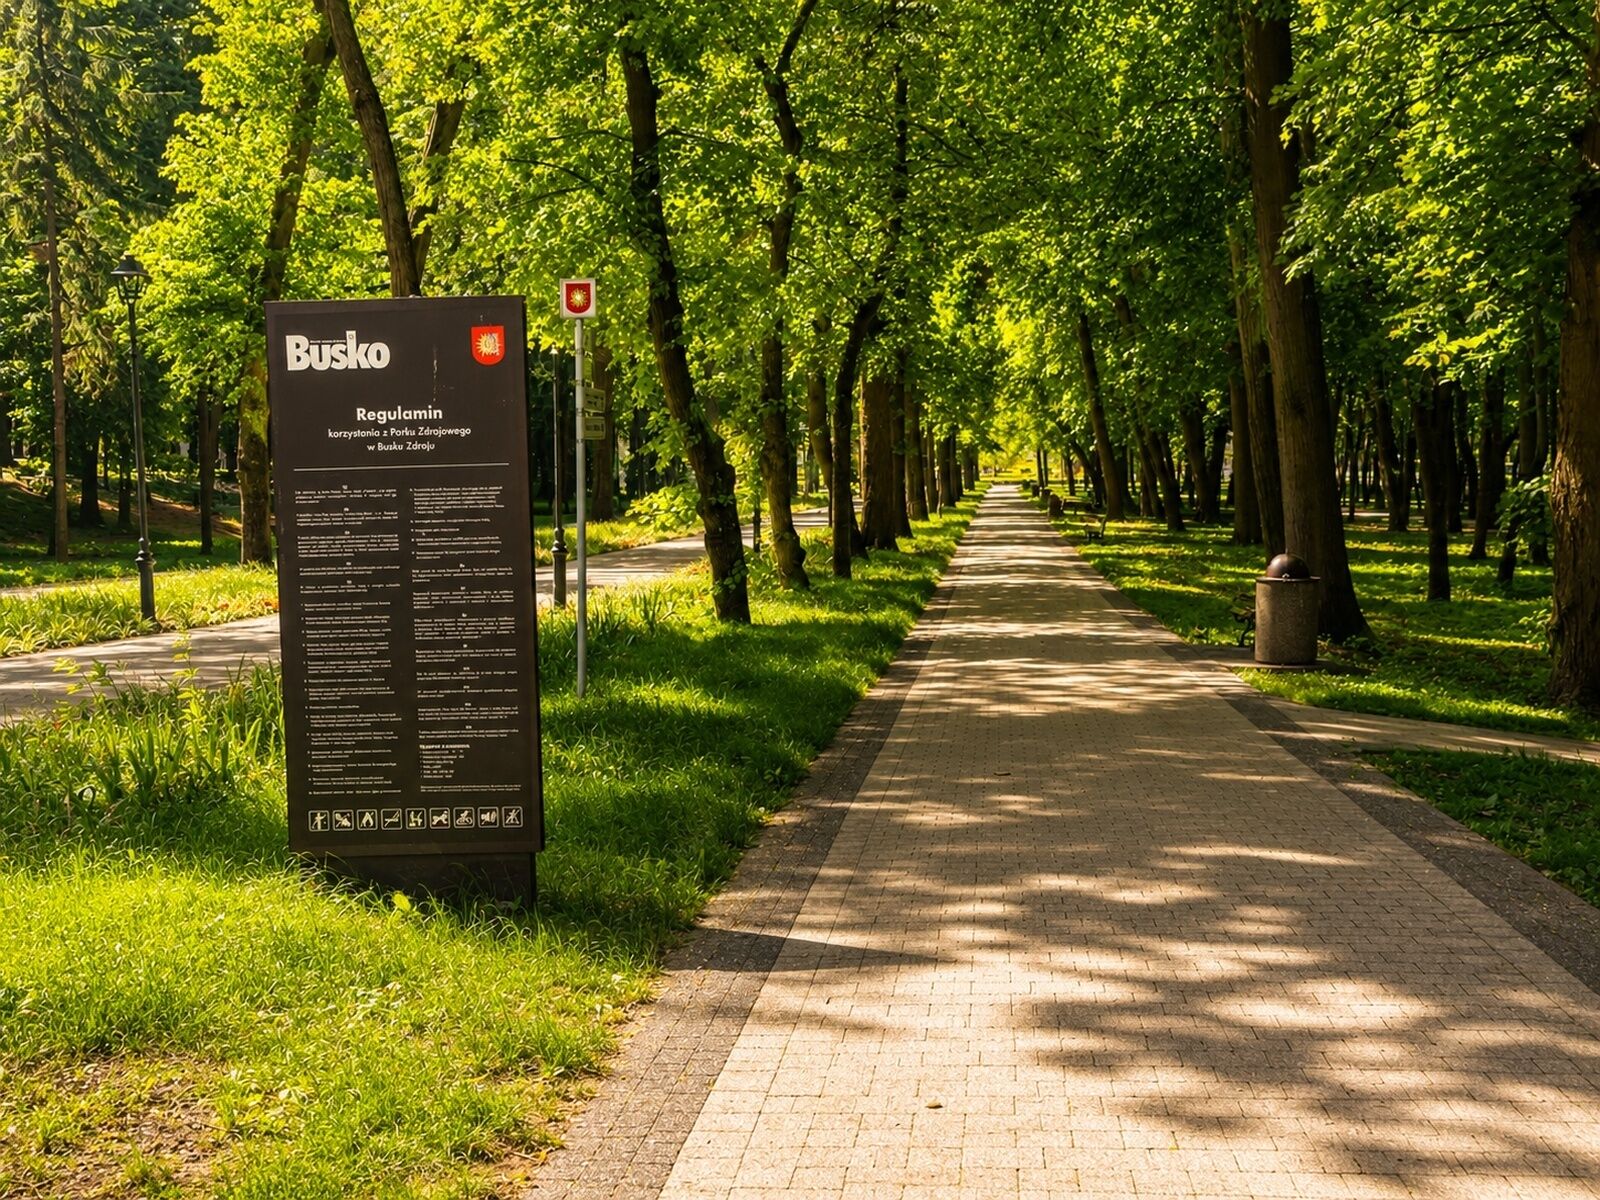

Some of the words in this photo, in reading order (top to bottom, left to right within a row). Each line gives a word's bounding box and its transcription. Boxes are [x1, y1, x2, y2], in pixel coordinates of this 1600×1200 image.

[286, 330, 391, 371] Busko
[357, 405, 443, 424] Regulamin
[418, 426, 472, 439] Zdrojowego
[367, 443, 376, 452] w
[406, 441, 435, 453] Zdroju
